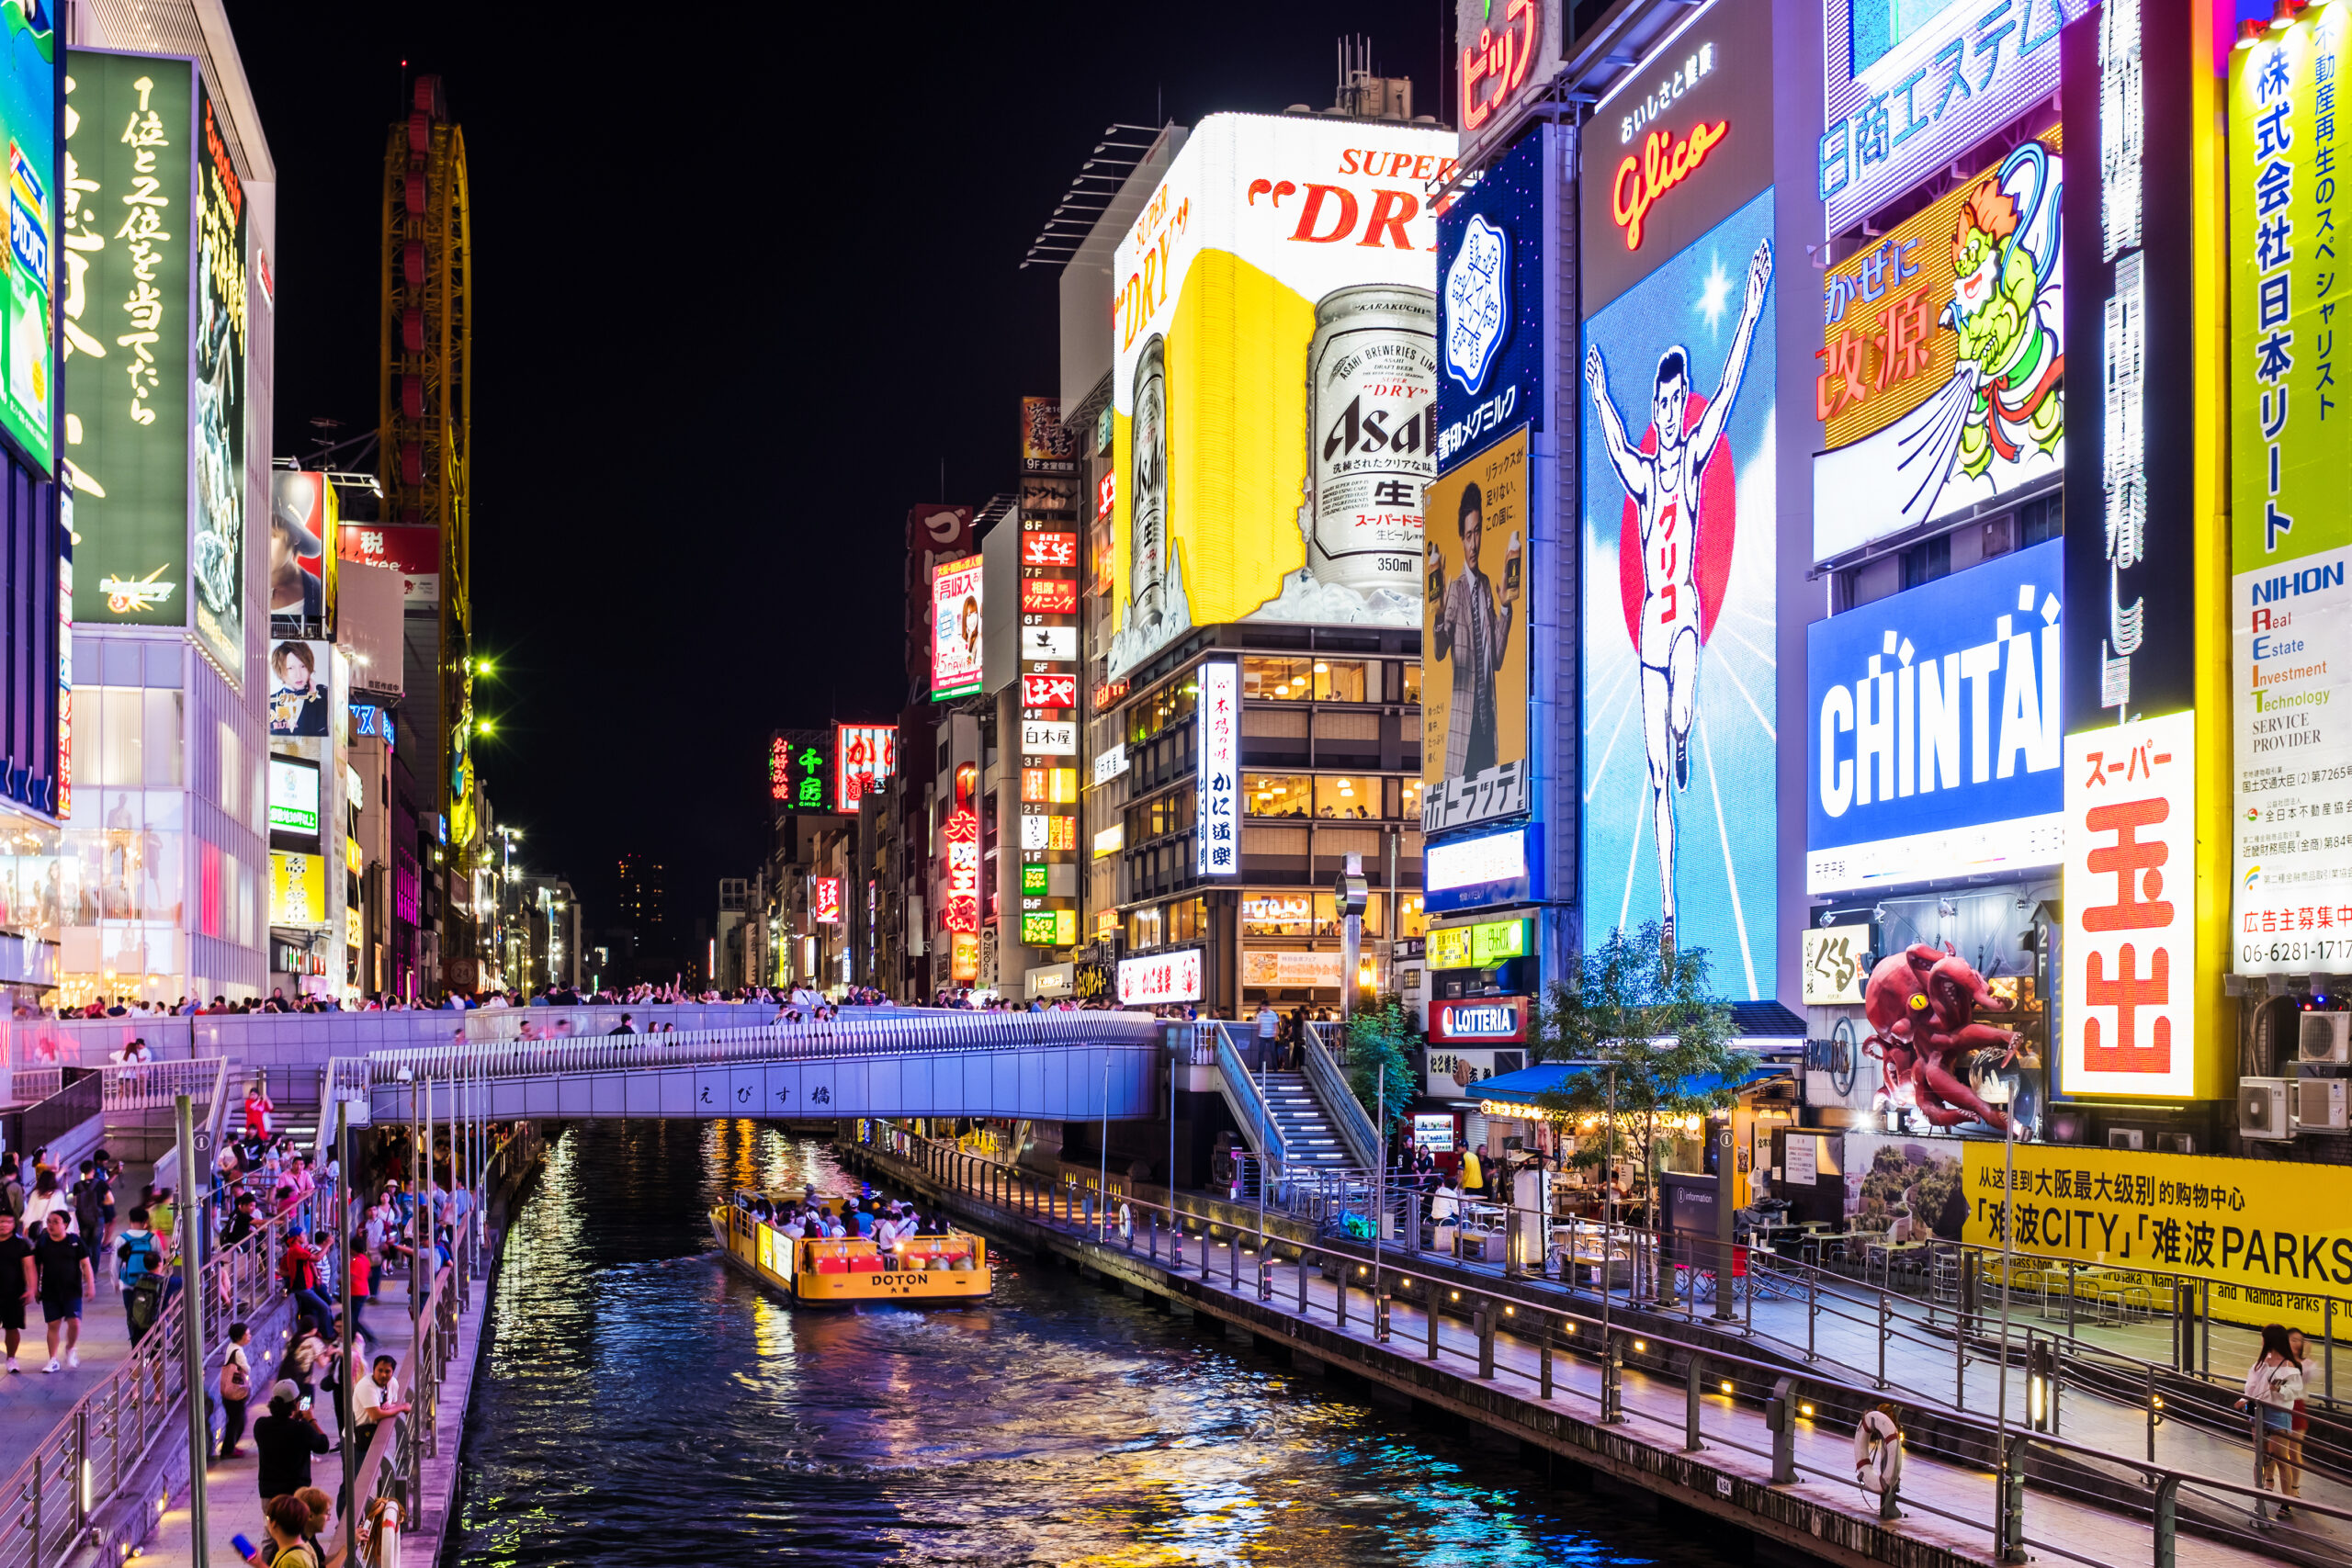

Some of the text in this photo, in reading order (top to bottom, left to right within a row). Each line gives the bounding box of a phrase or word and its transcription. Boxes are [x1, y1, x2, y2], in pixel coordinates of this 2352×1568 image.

[1621, 42, 1716, 144] おいしさと健康
[1818, 0, 2063, 204] 日商エステム
[1339, 149, 1460, 183] SUPER
[1612, 120, 1729, 251] Glico
[1136, 184, 1168, 254] SUPER
[2315, 22, 2335, 421] 不動産再生のスペシャリスト
[1825, 238, 1920, 324] かぜに
[2254, 47, 2293, 553] 株式会社日本リート
[1340, 355, 1363, 380] ASAHI
[1364, 344, 1417, 361] BREWERIES
[1816, 286, 1929, 422] 改源
[1438, 385, 1516, 461] 雪印メグミルク
[1486, 446, 1524, 482] リラックスが
[1374, 479, 1415, 507] 生
[361, 532, 383, 554] 税
[1377, 558, 1412, 572] 350ml
[1657, 493, 1678, 625] グリコ
[2252, 561, 2344, 606] NIHON
[1023, 595, 1076, 610] ダイニング
[2252, 608, 2291, 633] Real
[2253, 636, 2304, 660] Estate
[1034, 663, 1048, 672] 5F
[2253, 661, 2327, 687] Investment
[1025, 676, 1075, 705] はや
[1820, 585, 2061, 817] CHINTAI
[2251, 689, 2330, 713] Technology
[1025, 727, 1072, 745] 白木屋
[2253, 712, 2309, 735] SERVICE
[2254, 729, 2321, 753] PROVIDER
[798, 748, 823, 801] 千房
[2085, 738, 2173, 789] スーパー
[2243, 903, 2352, 932] 広告主募集中
[2082, 796, 2175, 1074] 玉出
[983, 942, 991, 963] ZERO
[1455, 1008, 1510, 1032] LOTTERIA
[1430, 1054, 1458, 1074] たこ焼き
[701, 1085, 831, 1106] えびす橋
[1686, 1192, 1713, 1203] information
[872, 1274, 929, 1286] DOTON
[2218, 1284, 2237, 1301] and
